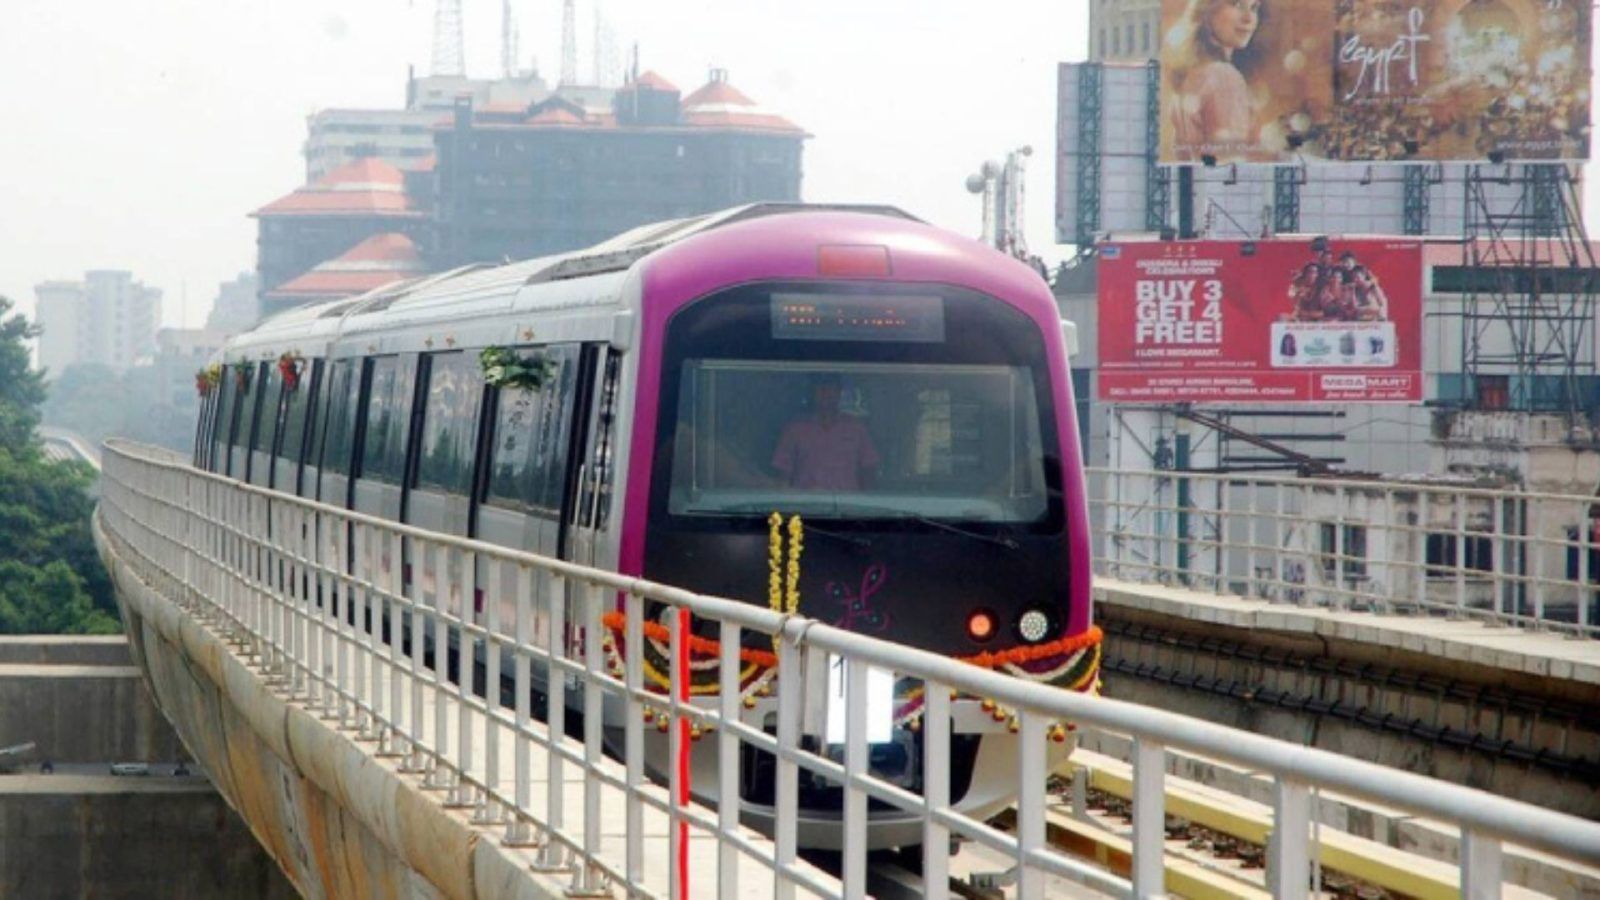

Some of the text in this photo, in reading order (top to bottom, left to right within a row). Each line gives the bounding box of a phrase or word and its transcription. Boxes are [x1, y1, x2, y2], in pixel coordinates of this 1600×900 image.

[1339, 7, 1430, 100] egypt
[1136, 280, 1222, 301] BUY 3
[1136, 302, 1222, 322] GET 4
[1136, 322, 1222, 343] FREE!
[1141, 349, 1165, 357] LOVE
[1324, 378, 1408, 386] MEGA MART
